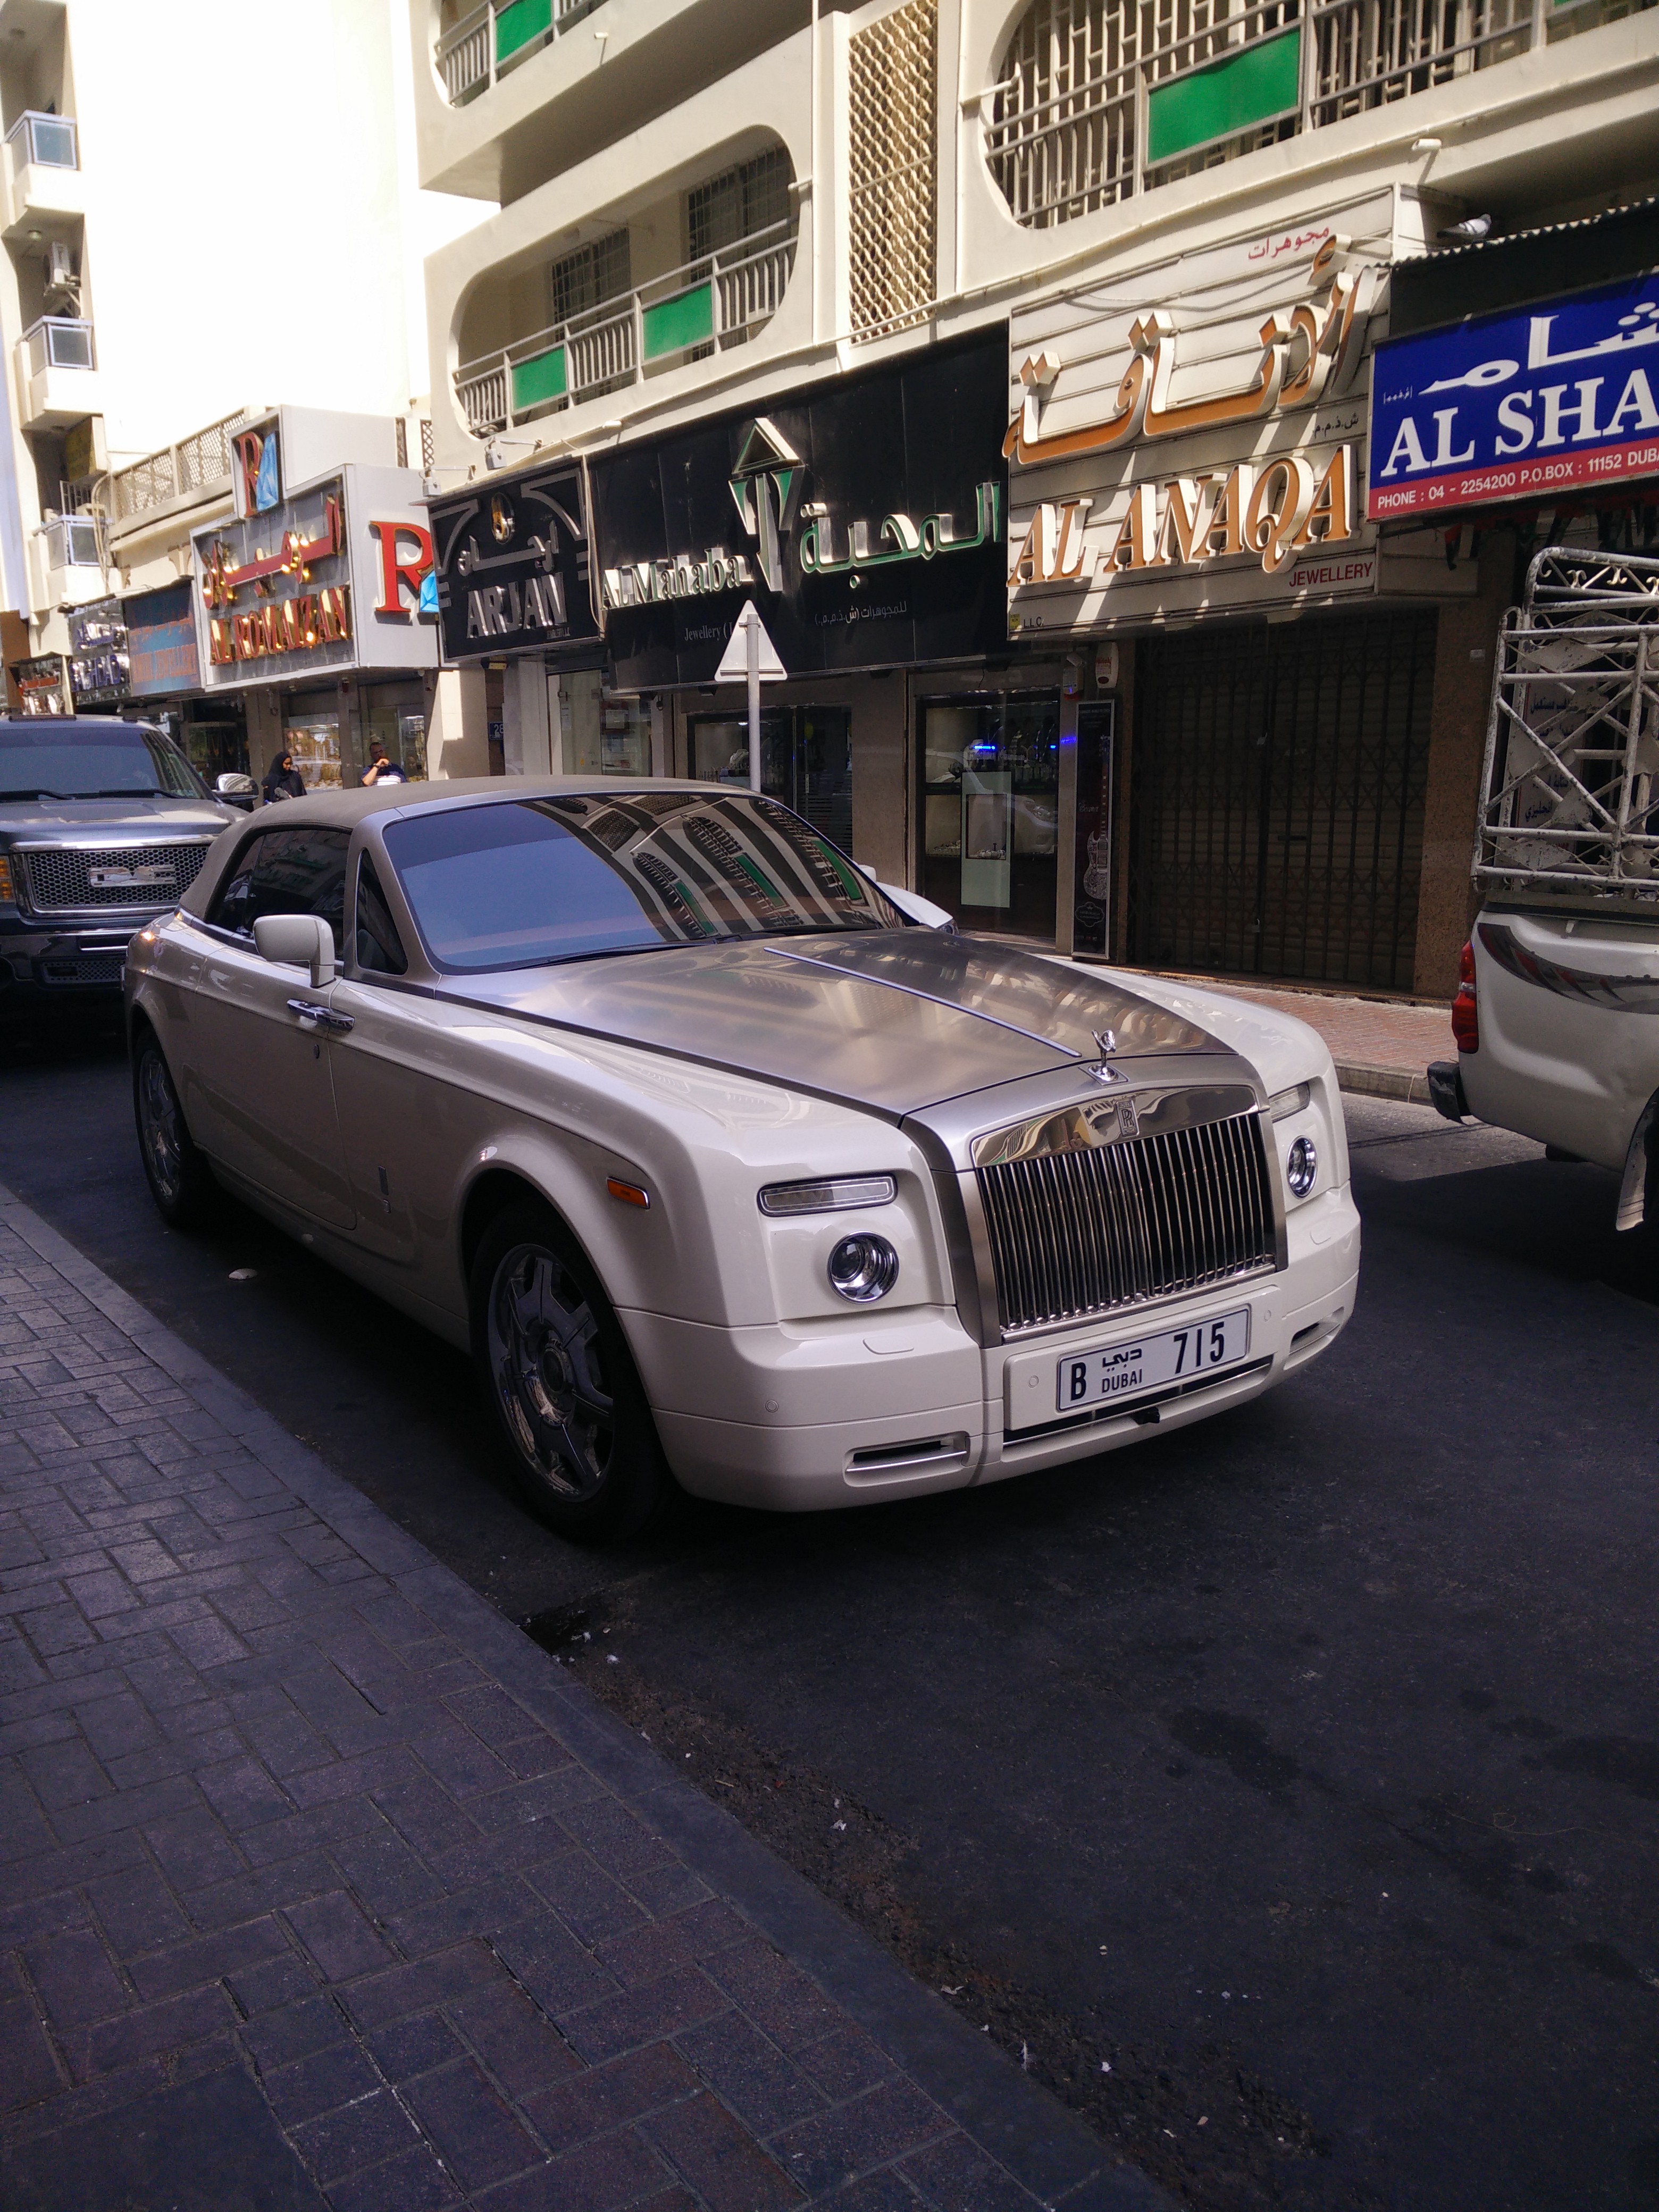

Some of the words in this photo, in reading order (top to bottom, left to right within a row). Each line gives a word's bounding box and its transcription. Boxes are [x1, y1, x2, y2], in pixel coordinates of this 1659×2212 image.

[1248, 227, 1329, 259] مجوهرات
[1381, 407, 1475, 477] AL
[1495, 368, 1659, 456] SHA
[1378, 490, 1417, 509] PHONE
[1428, 484, 1445, 500] 04
[1460, 471, 1516, 495] 2254200
[1520, 461, 1574, 484] P.O.BOX
[1587, 453, 1622, 473] 11152
[1627, 448, 1659, 466] DUB
[800, 481, 1001, 589] المحبة
[1007, 499, 1096, 587] AL
[1103, 445, 1351, 574] ANAQA
[466, 572, 567, 638] ARJAN
[1289, 562, 1373, 588] JEWELLERY
[210, 618, 232, 666] AL
[232, 585, 351, 660] ROMAIZAN
[684, 624, 722, 641] Jewellery
[860, 600, 908, 620] للمجوهرات
[1070, 1362, 1086, 1401] B
[1173, 1321, 1225, 1375] 715
[1102, 1348, 1142, 1372] دبي
[1102, 1369, 1143, 1393] DUBAI
